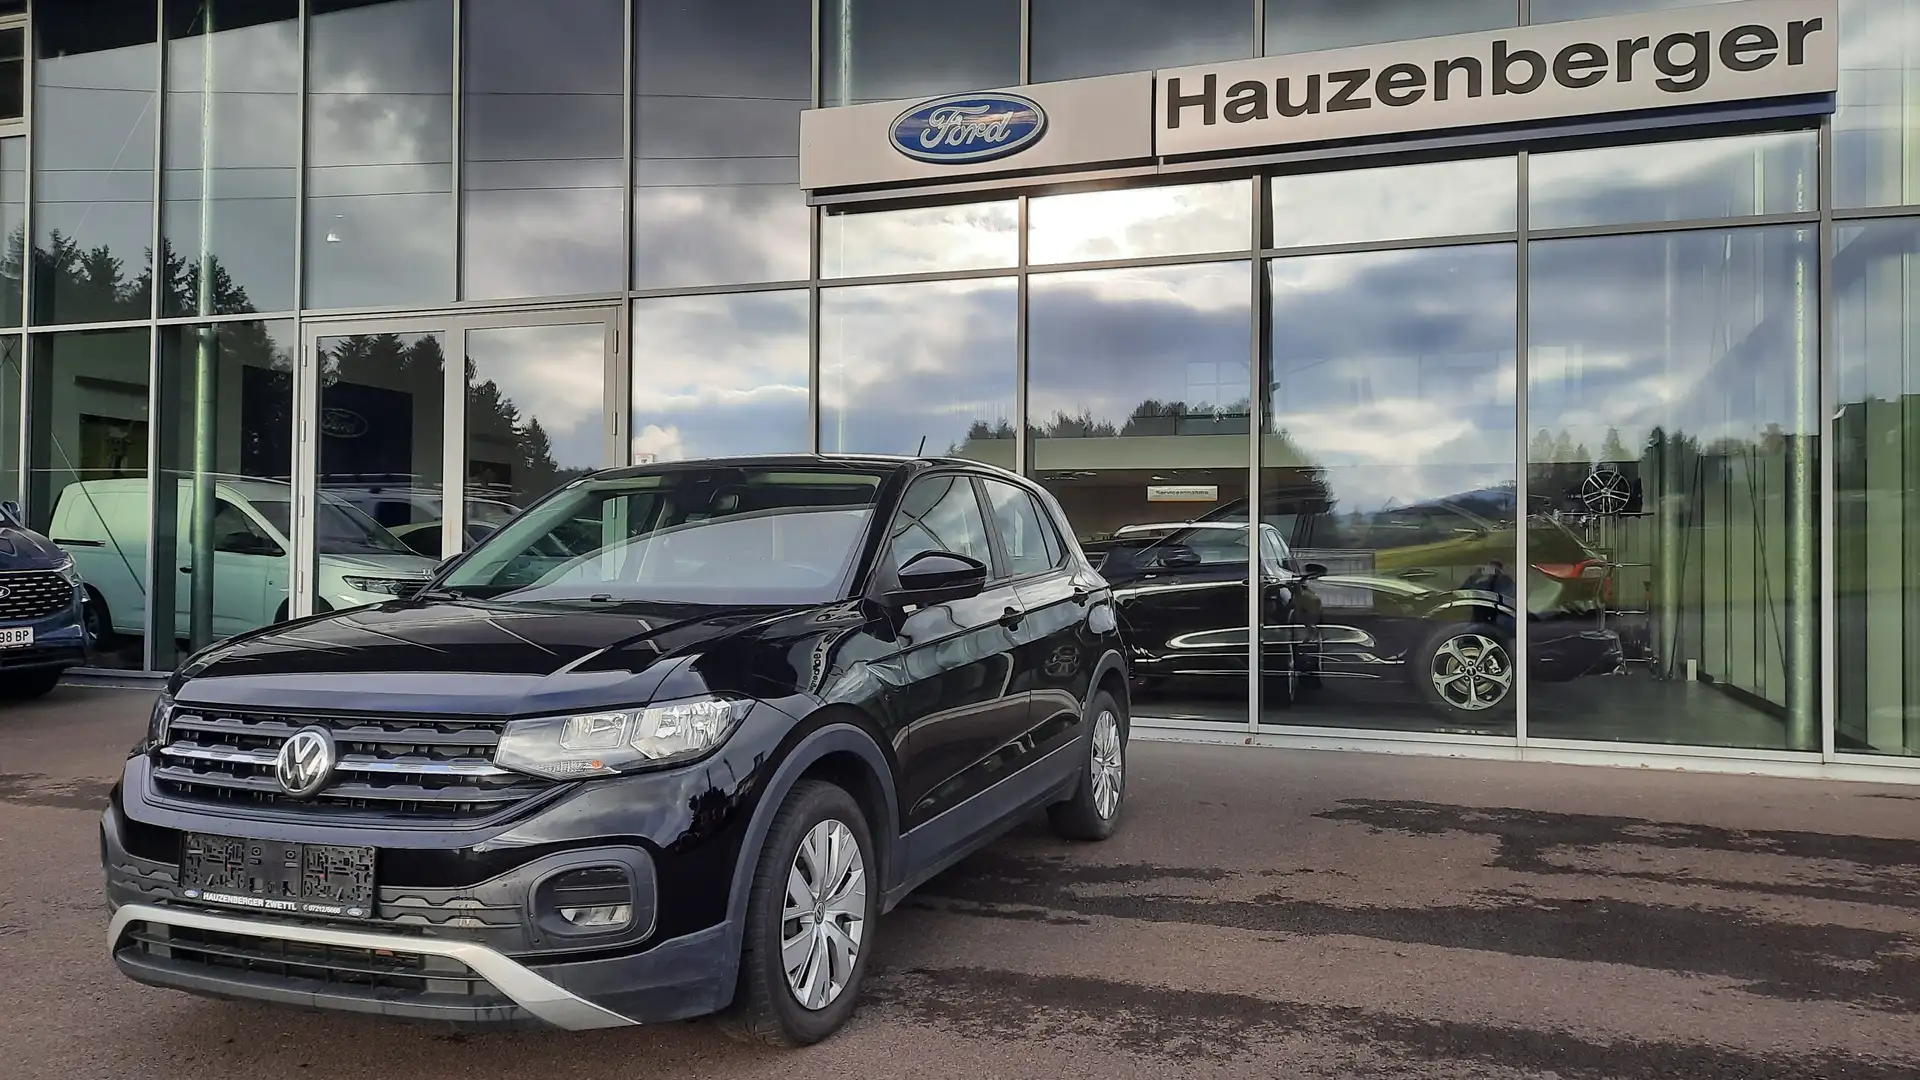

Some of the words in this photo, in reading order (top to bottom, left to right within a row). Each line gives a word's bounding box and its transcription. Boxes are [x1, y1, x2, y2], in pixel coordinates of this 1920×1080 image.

[1167, 17, 1824, 130] Hauzenberger
[919, 104, 1014, 149] Ford
[15, 630, 29, 642] BP
[202, 892, 264, 907] HAUZENBERGER
[264, 899, 298, 911] ZWETTL
